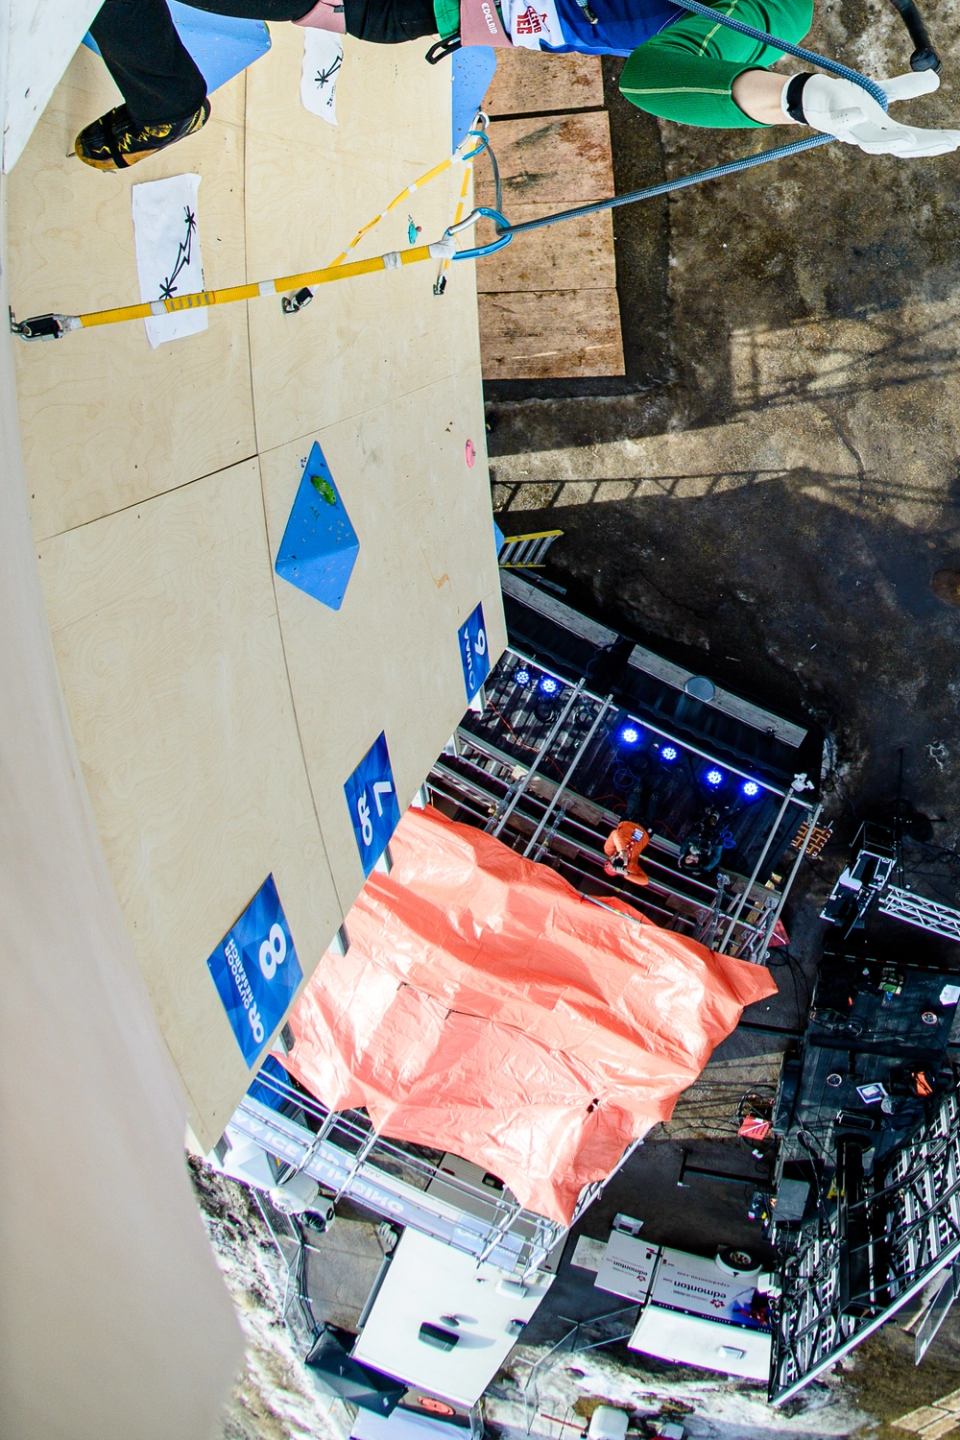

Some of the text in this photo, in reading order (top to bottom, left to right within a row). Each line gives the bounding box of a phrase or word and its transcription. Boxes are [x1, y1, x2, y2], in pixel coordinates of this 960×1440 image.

[481, 2, 498, 35] EDELRID
[516, 9, 533, 35] YEG
[463, 626, 474, 669] UIAA
[357, 793, 374, 847] OR
[373, 780, 393, 818] 7
[227, 938, 256, 1005] RESEARCH
[258, 921, 288, 981] 8
[223, 948, 248, 1011] OUTDOOR
[243, 1000, 265, 1044] OR
[672, 1279, 728, 1299] edmonton
